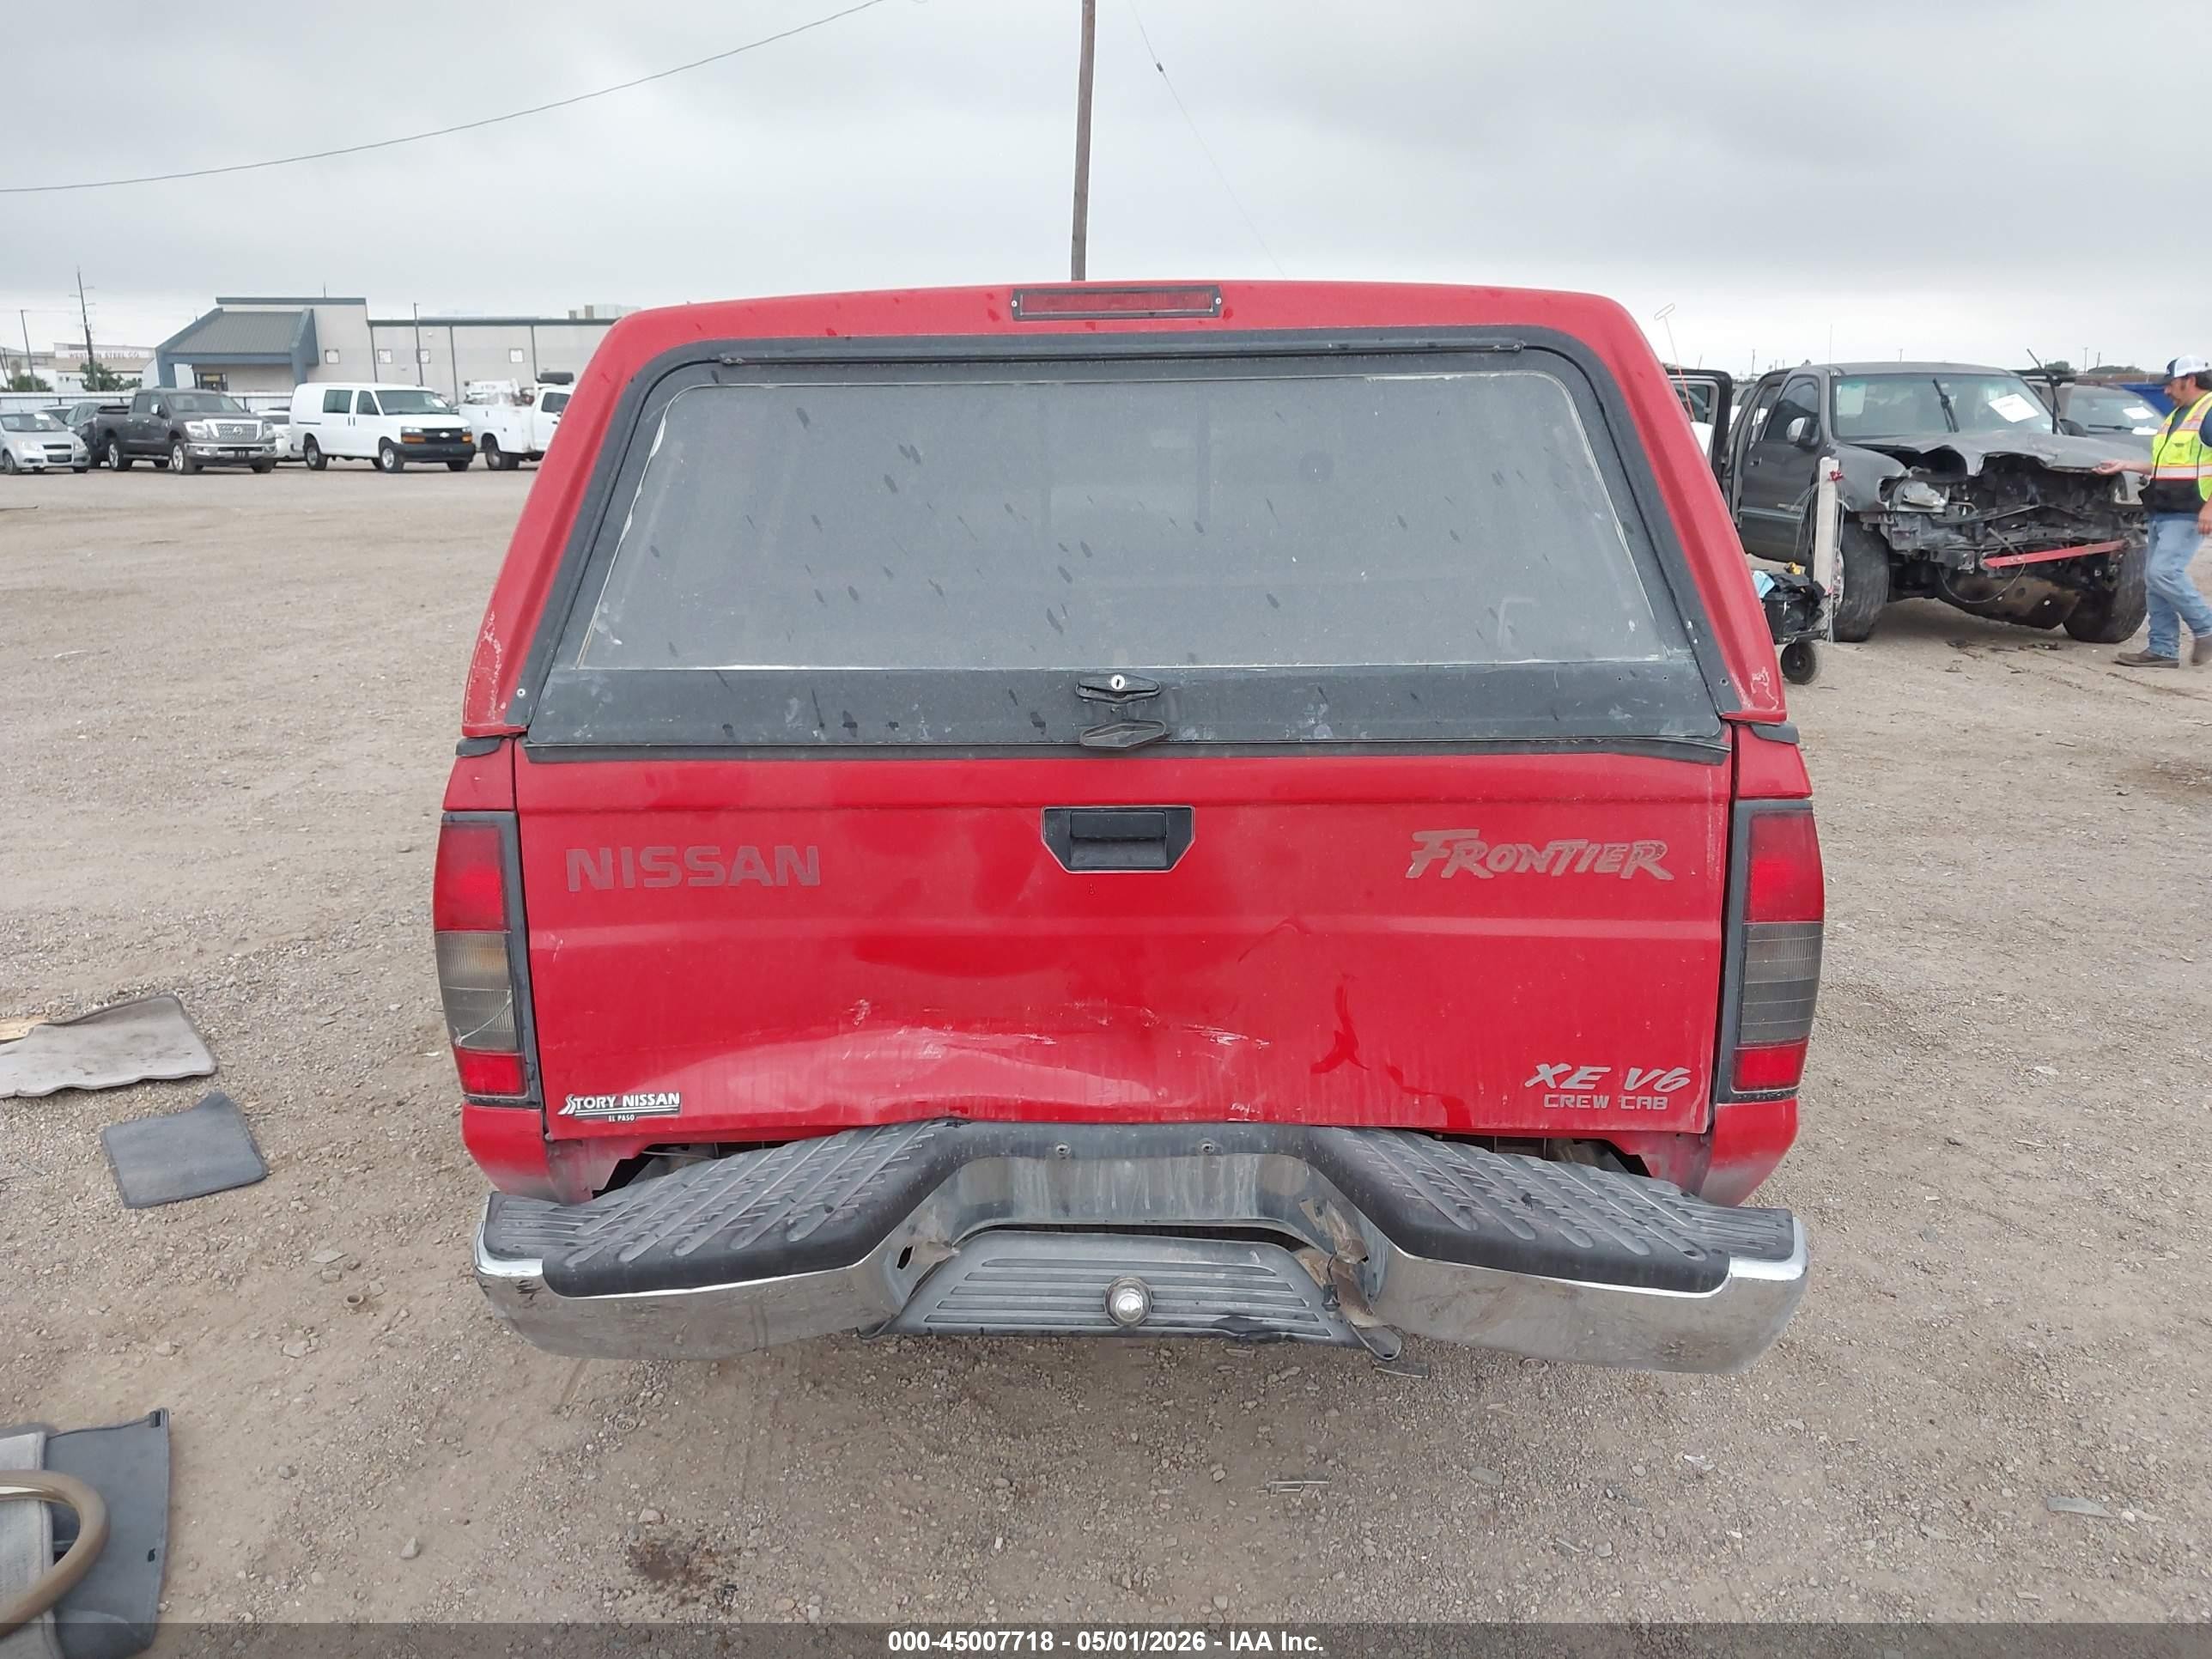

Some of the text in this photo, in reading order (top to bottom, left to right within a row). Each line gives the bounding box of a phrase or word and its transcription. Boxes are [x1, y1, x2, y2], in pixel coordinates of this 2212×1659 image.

[565, 845, 821, 892] NISSAN
[1405, 829, 1674, 880] FRONTIER
[1524, 1063, 1691, 1092] XE V6
[557, 1092, 680, 1115] STORY NISSAN
[1543, 1094, 1668, 1110] CREW CAB
